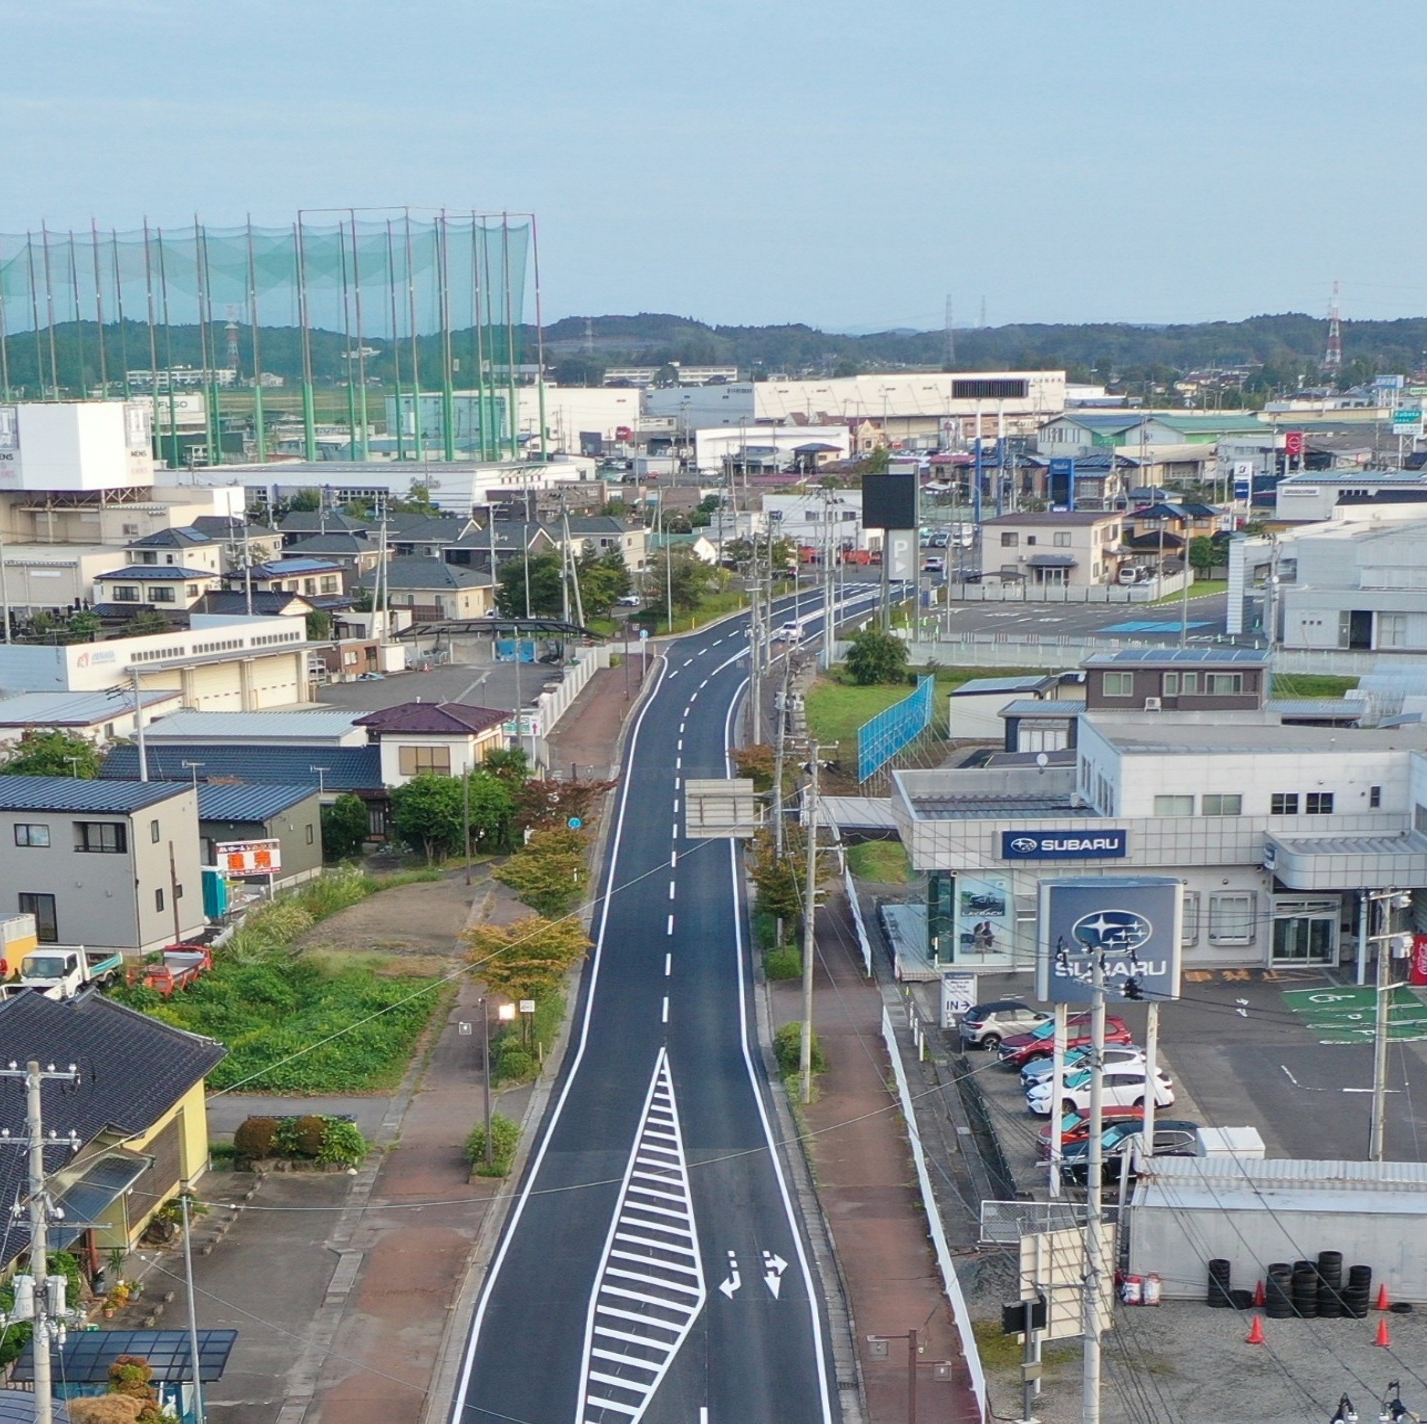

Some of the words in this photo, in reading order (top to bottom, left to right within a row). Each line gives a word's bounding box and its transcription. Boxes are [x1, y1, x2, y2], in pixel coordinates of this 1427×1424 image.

[894, 540, 908, 558] P
[1041, 838, 1119, 851] SUBARU
[946, 1000, 959, 1011] IN
